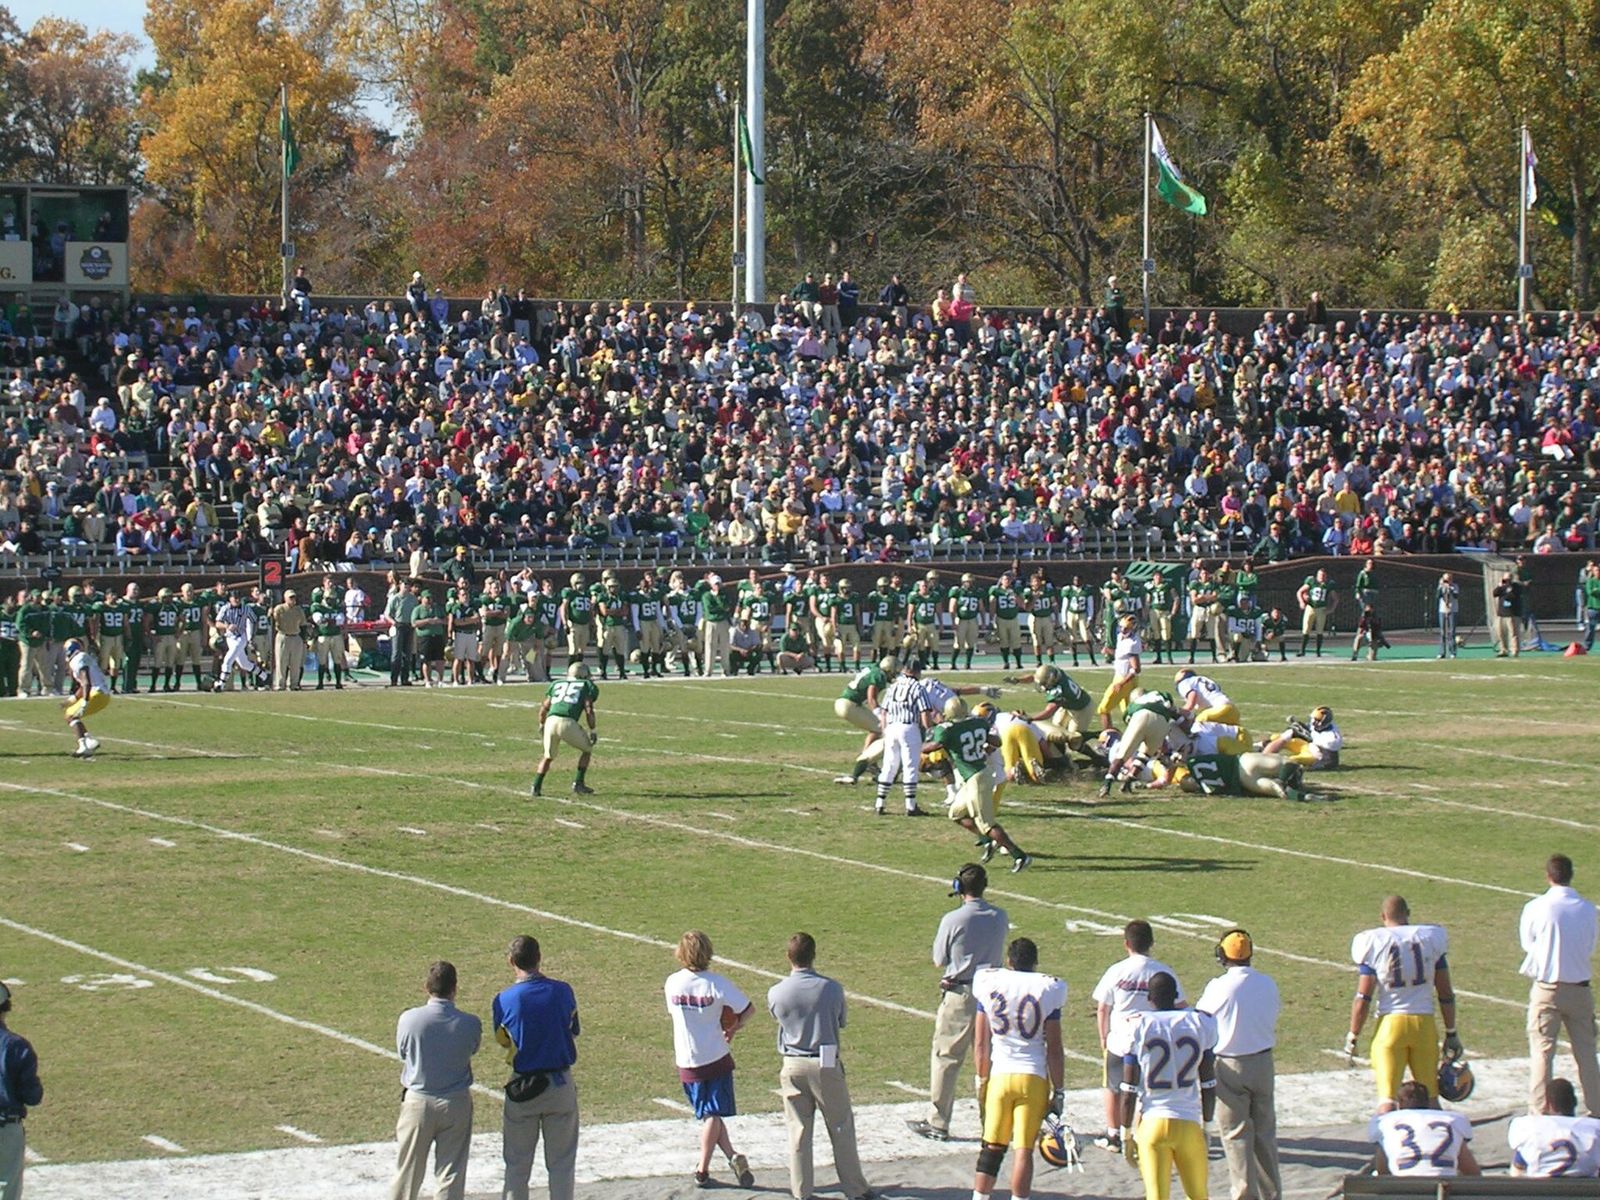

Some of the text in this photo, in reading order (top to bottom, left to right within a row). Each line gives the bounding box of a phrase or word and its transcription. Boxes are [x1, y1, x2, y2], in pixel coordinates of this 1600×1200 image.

[264, 562, 282, 584] 2
[104, 611, 124, 627] 92
[751, 602, 769, 618] 30
[844, 603, 854, 618] 3
[878, 602, 889, 616] 2
[550, 681, 585, 704] 35
[960, 728, 988, 762] 22
[1388, 942, 1427, 989] 11
[989, 990, 1042, 1040] 30
[1145, 1036, 1201, 1089] 22
[1394, 1121, 1455, 1171] 32
